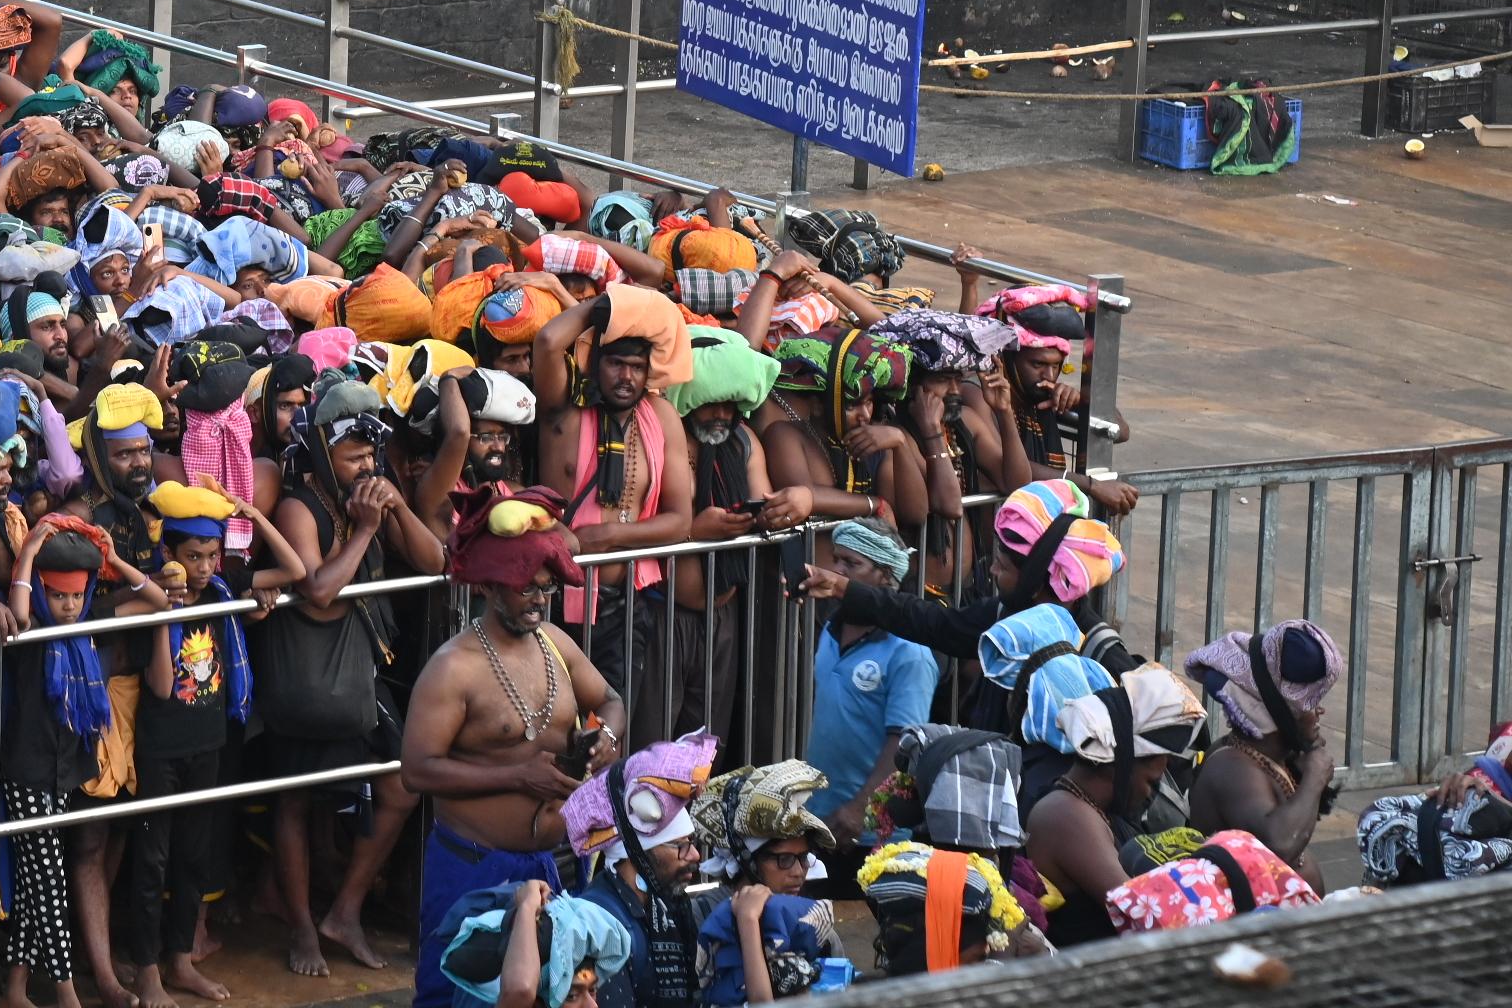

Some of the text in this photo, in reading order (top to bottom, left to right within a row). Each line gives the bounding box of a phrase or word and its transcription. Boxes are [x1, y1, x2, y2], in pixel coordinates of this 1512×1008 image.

[680, 38, 905, 162] தேங்காய் பாதுகாப்பாக எறிந்து உடைக்கவும்
[806, 36, 849, 88] அபாயம்
[849, 50, 902, 106] இல்லாமல்
